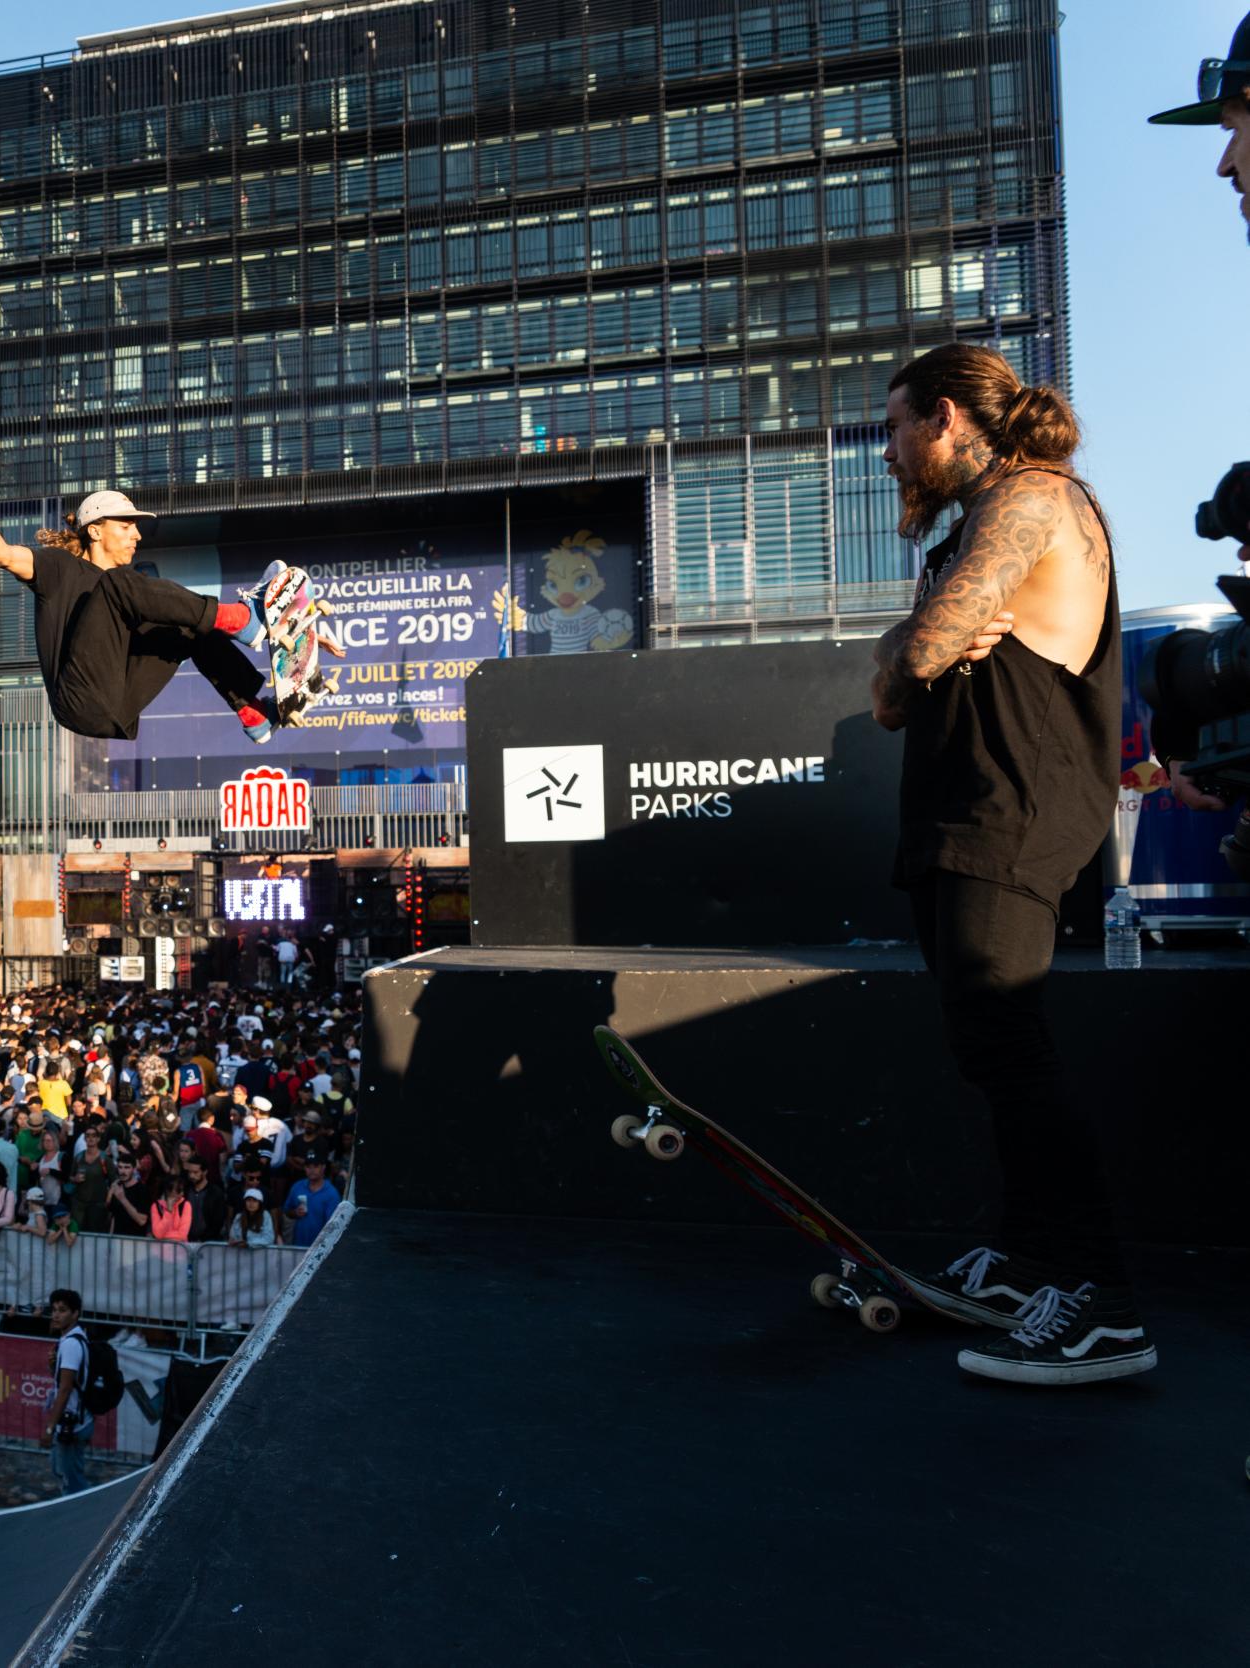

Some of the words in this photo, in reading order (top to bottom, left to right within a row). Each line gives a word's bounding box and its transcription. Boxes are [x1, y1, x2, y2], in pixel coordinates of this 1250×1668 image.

[446, 573, 473, 590] LA
[330, 602, 356, 613] NDE
[357, 597, 413, 612] FÉMININE
[414, 598, 430, 609] DE
[430, 597, 447, 608] LA
[447, 595, 473, 607] FIFA
[318, 616, 390, 648] NCE
[346, 662, 428, 684] JUILLET
[432, 661, 478, 680] 2019
[356, 691, 385, 705] vos
[629, 756, 825, 788] HURRICANE
[630, 792, 732, 820] PARKS
